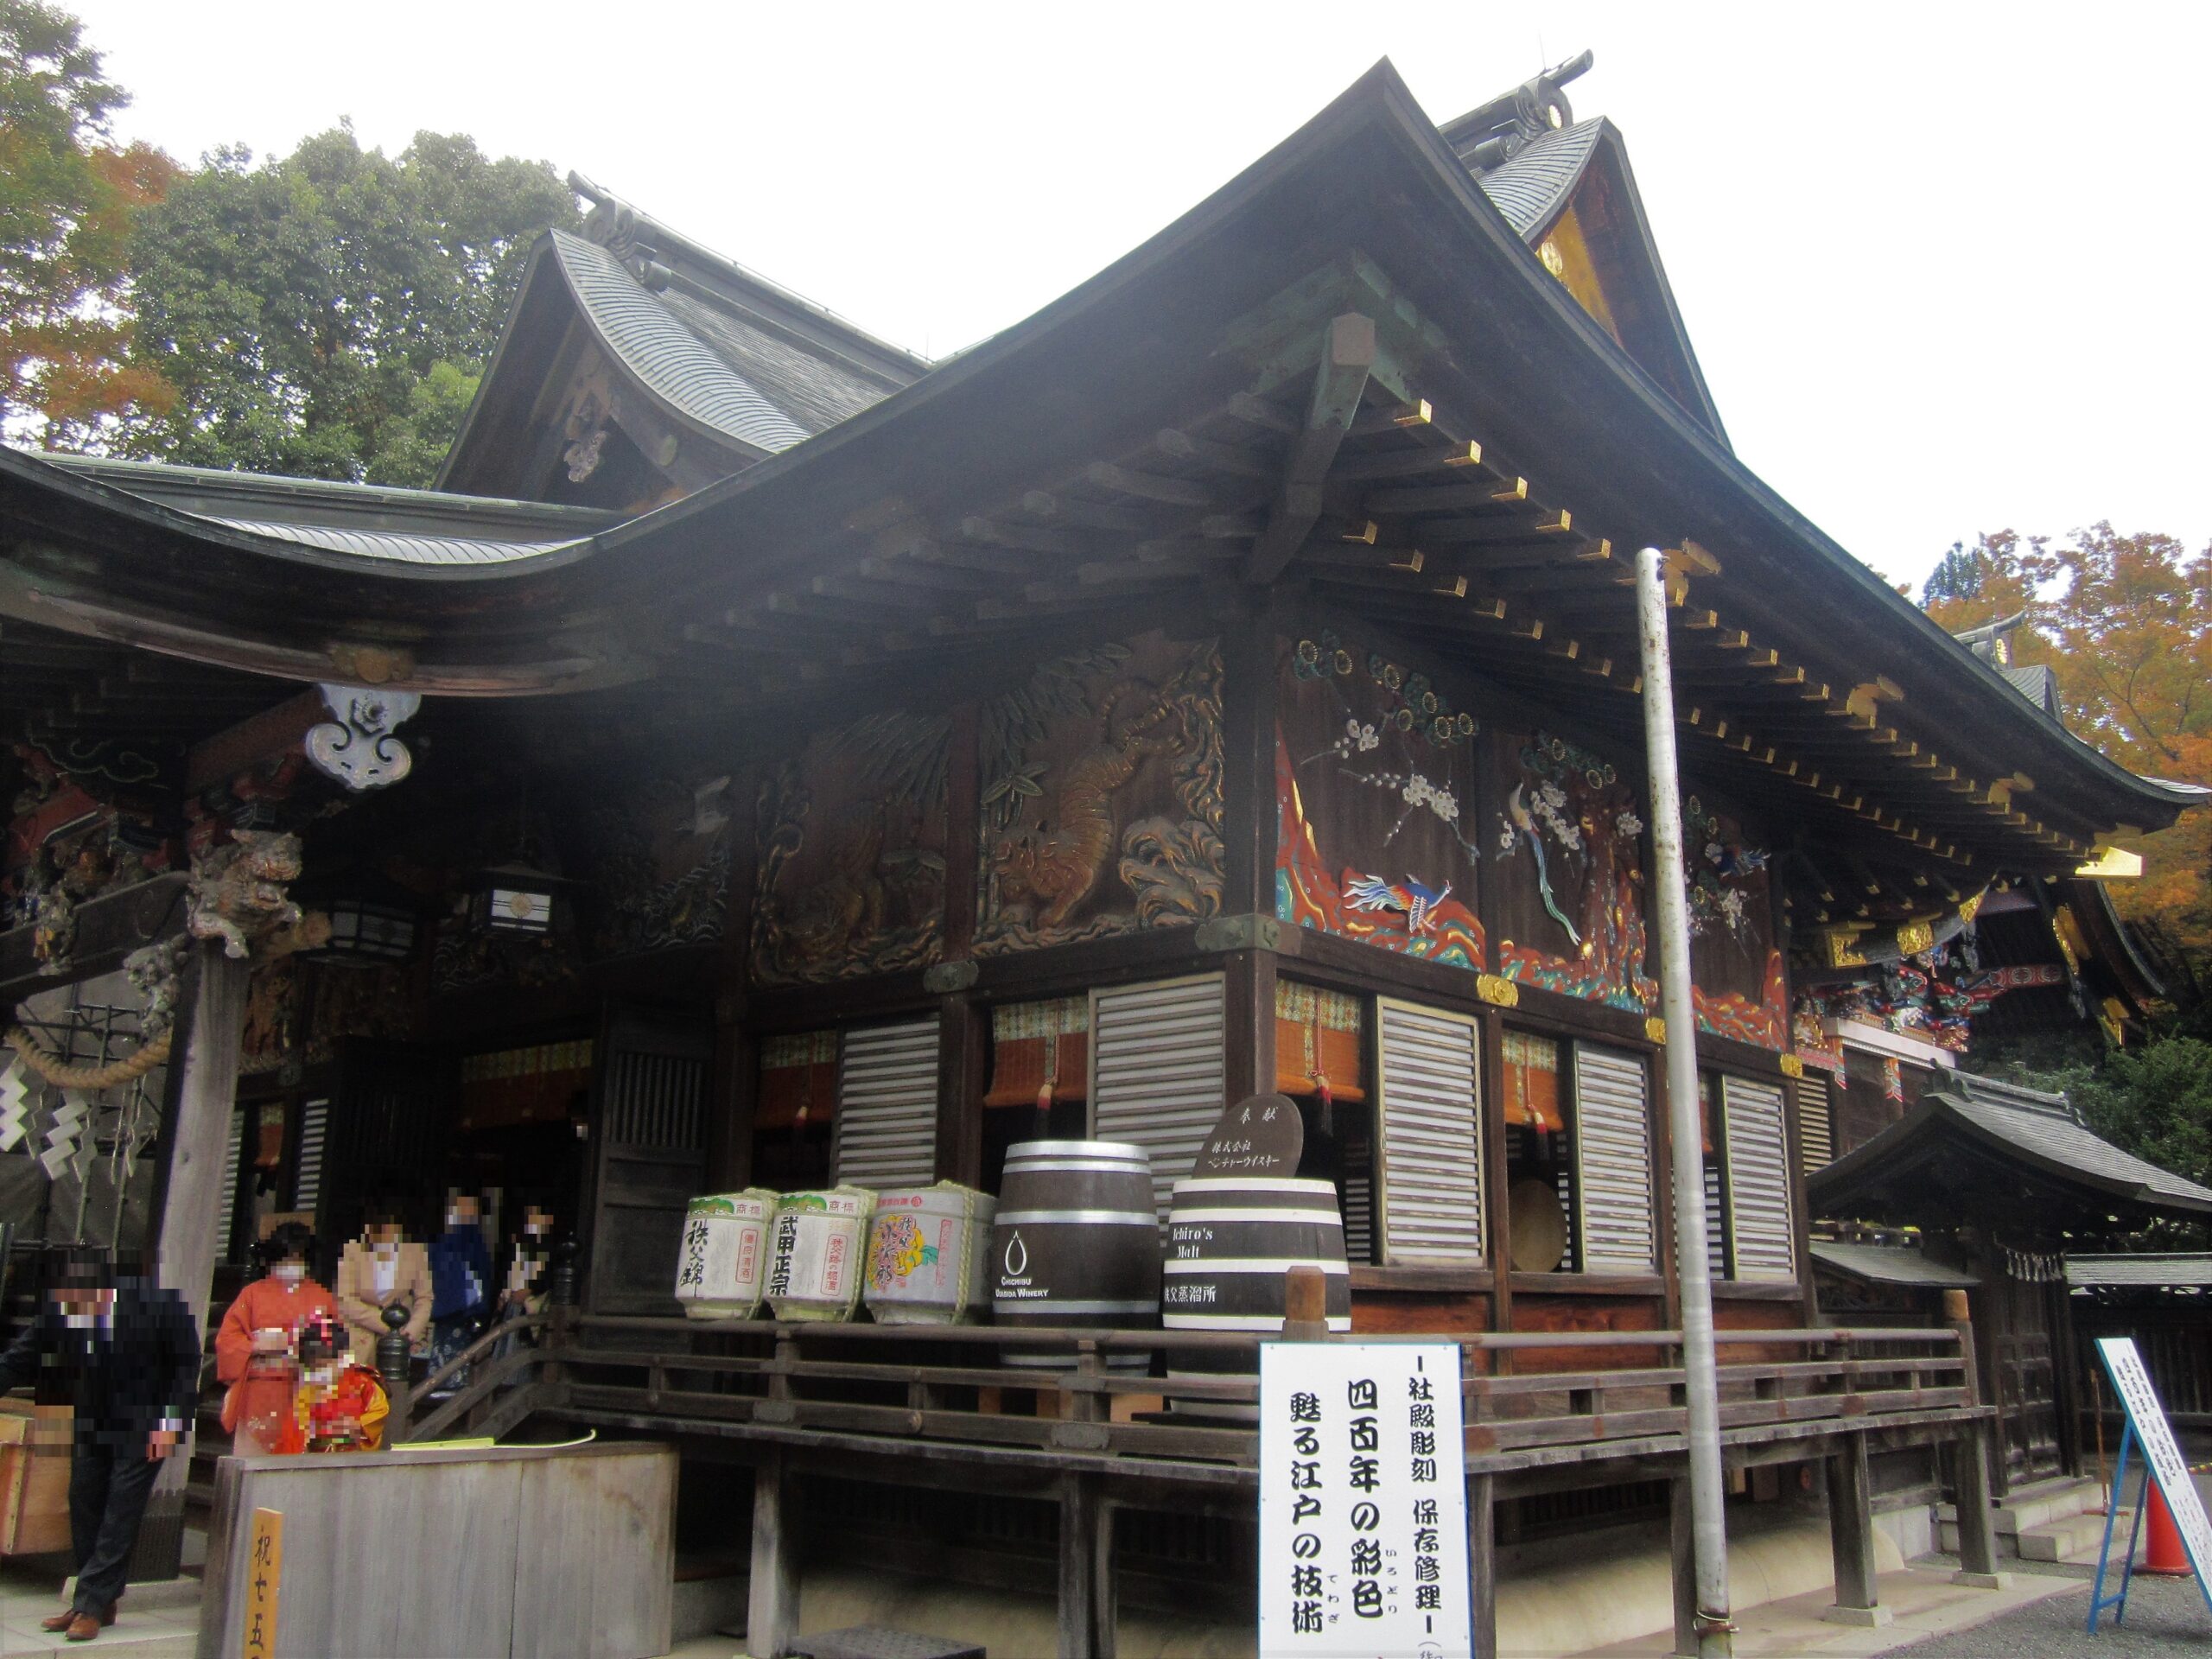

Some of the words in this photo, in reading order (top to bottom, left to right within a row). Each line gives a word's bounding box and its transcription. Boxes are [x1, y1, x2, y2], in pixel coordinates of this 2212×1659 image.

[1211, 1140, 1251, 1154] 株式会社
[679, 1219, 709, 1297] 秩父錦
[769, 1216, 798, 1296] 武甲正宗
[1173, 1227, 1213, 1241] Ichiro's
[1178, 1245, 1199, 1258] Malt
[1290, 1392, 1324, 1634] 甦る江戸の技術
[1348, 1379, 1383, 1618] 四百年の彩色
[250, 1524, 272, 1659] 祝七五
[1385, 1549, 1397, 1614] いろどり
